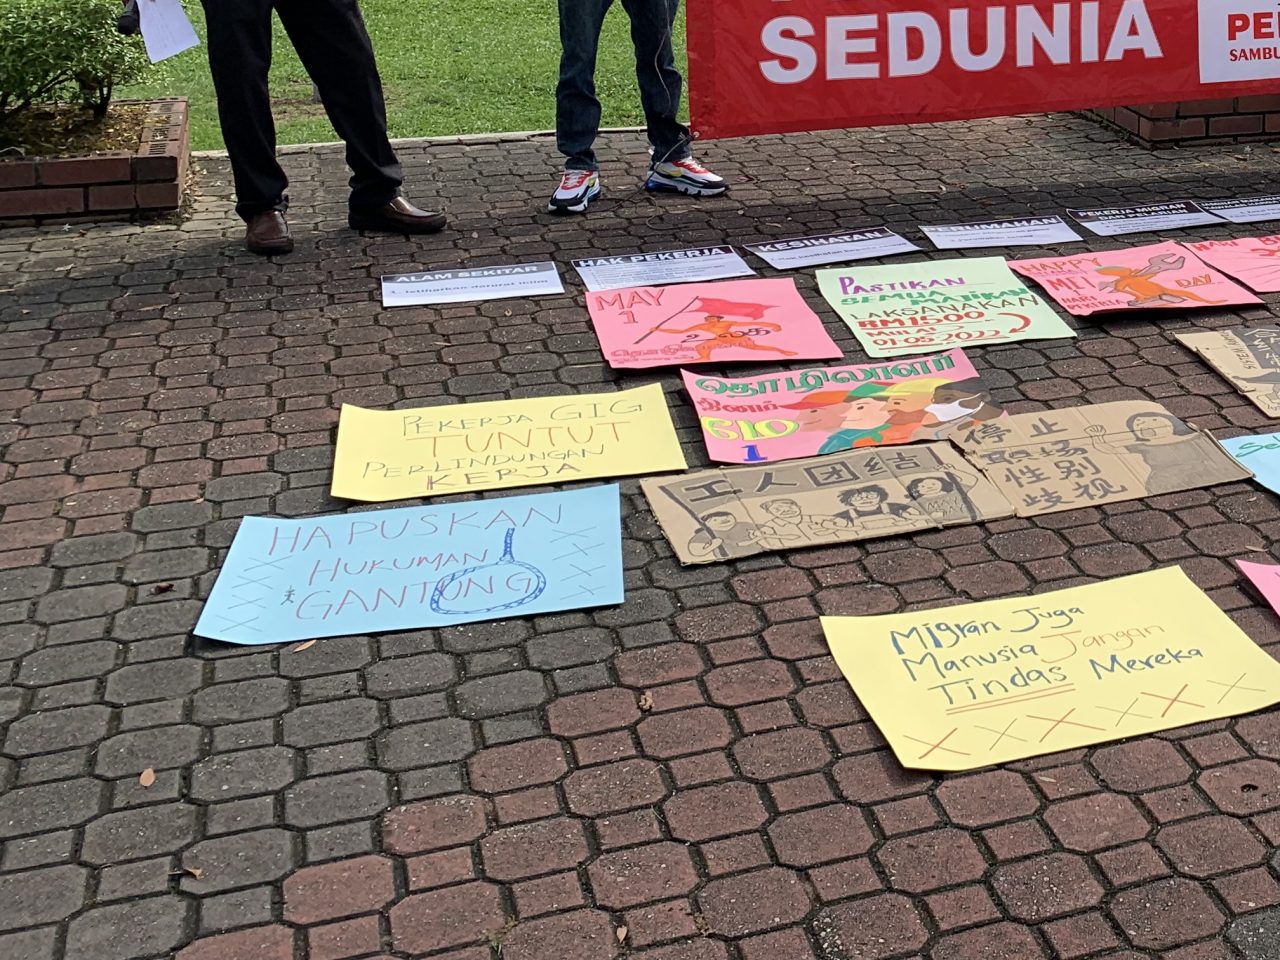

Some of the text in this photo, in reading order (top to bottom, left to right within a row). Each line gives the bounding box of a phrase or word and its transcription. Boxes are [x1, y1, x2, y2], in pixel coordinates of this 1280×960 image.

[1078, 202, 1186, 218] PEKERJA MIGRAN
[923, 217, 1059, 232] PERUMAHAN
[757, 231, 884, 252] KESIHATAN
[1191, 241, 1239, 252] HARI
[579, 248, 725, 268] HAK PEKERJA
[1018, 257, 1103, 272] HAPPY
[396, 266, 539, 283] ALAM SEKITAR
[1046, 276, 1097, 292] MEI
[1174, 273, 1213, 289] DAY
[595, 288, 666, 311] MAY
[841, 290, 947, 306] SEMUA
[849, 294, 1040, 321] LAKSANAKAN
[1060, 295, 1098, 303] HARI
[617, 310, 638, 324] 1
[857, 311, 986, 328] RM1500
[402, 399, 643, 436] PEKERJA GIG
[963, 416, 1068, 444] 停止
[405, 421, 631, 458] TUNTUT
[983, 439, 1089, 466] 职场
[363, 444, 604, 479] PERLINDUNGAN
[740, 444, 768, 463] 1
[427, 463, 582, 491] KERJA
[682, 449, 925, 503] 工人团结
[1003, 456, 1103, 488] 性别
[1022, 478, 1129, 511] 歧视
[268, 504, 563, 556] HAPUSKAN
[309, 549, 489, 587] HUKUMAN
[295, 572, 532, 621] GANTUNG
[889, 606, 1085, 655] Migran Juga
[901, 624, 1166, 682] Manusia Jangan
[927, 647, 1204, 705] Tindas Mereka
